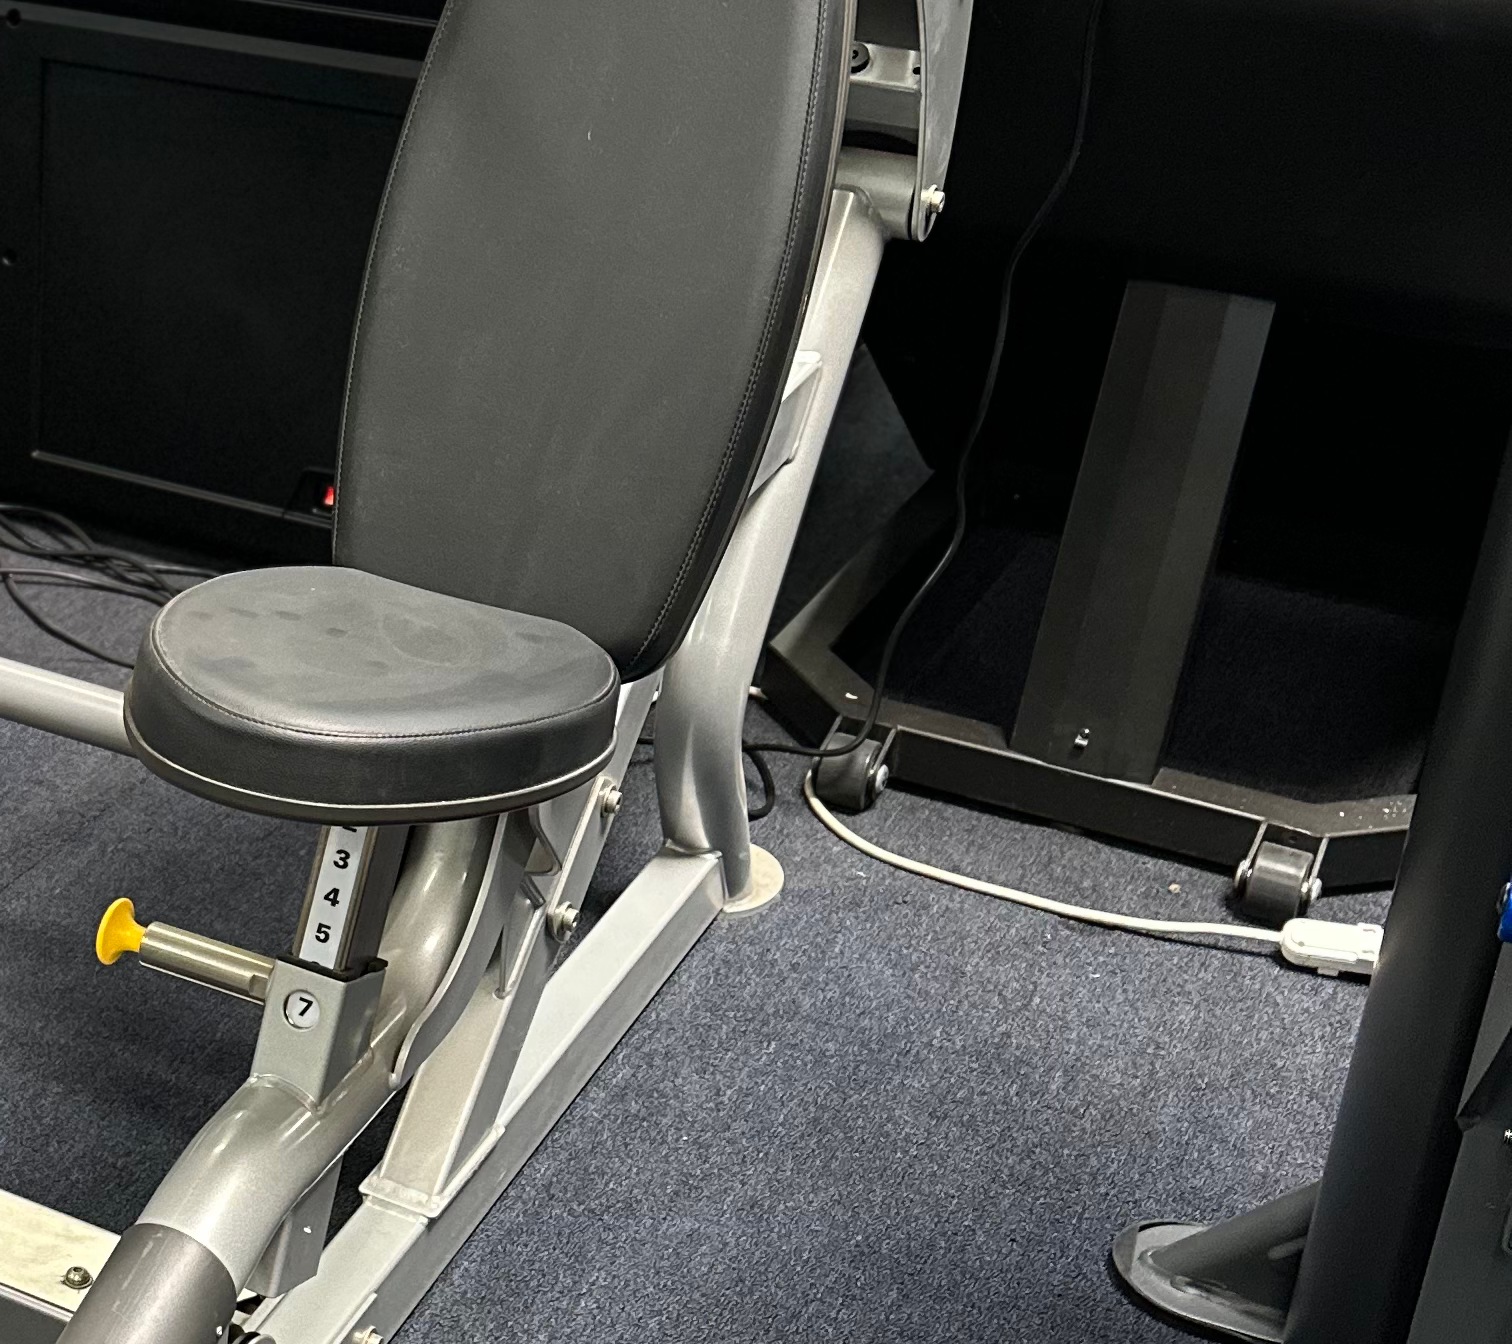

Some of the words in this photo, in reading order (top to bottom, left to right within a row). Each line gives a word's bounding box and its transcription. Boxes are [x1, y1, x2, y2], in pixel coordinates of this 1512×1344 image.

[333, 849, 351, 870] 3
[323, 887, 340, 907] 4
[314, 922, 332, 944] 5
[298, 996, 314, 1017] 7
